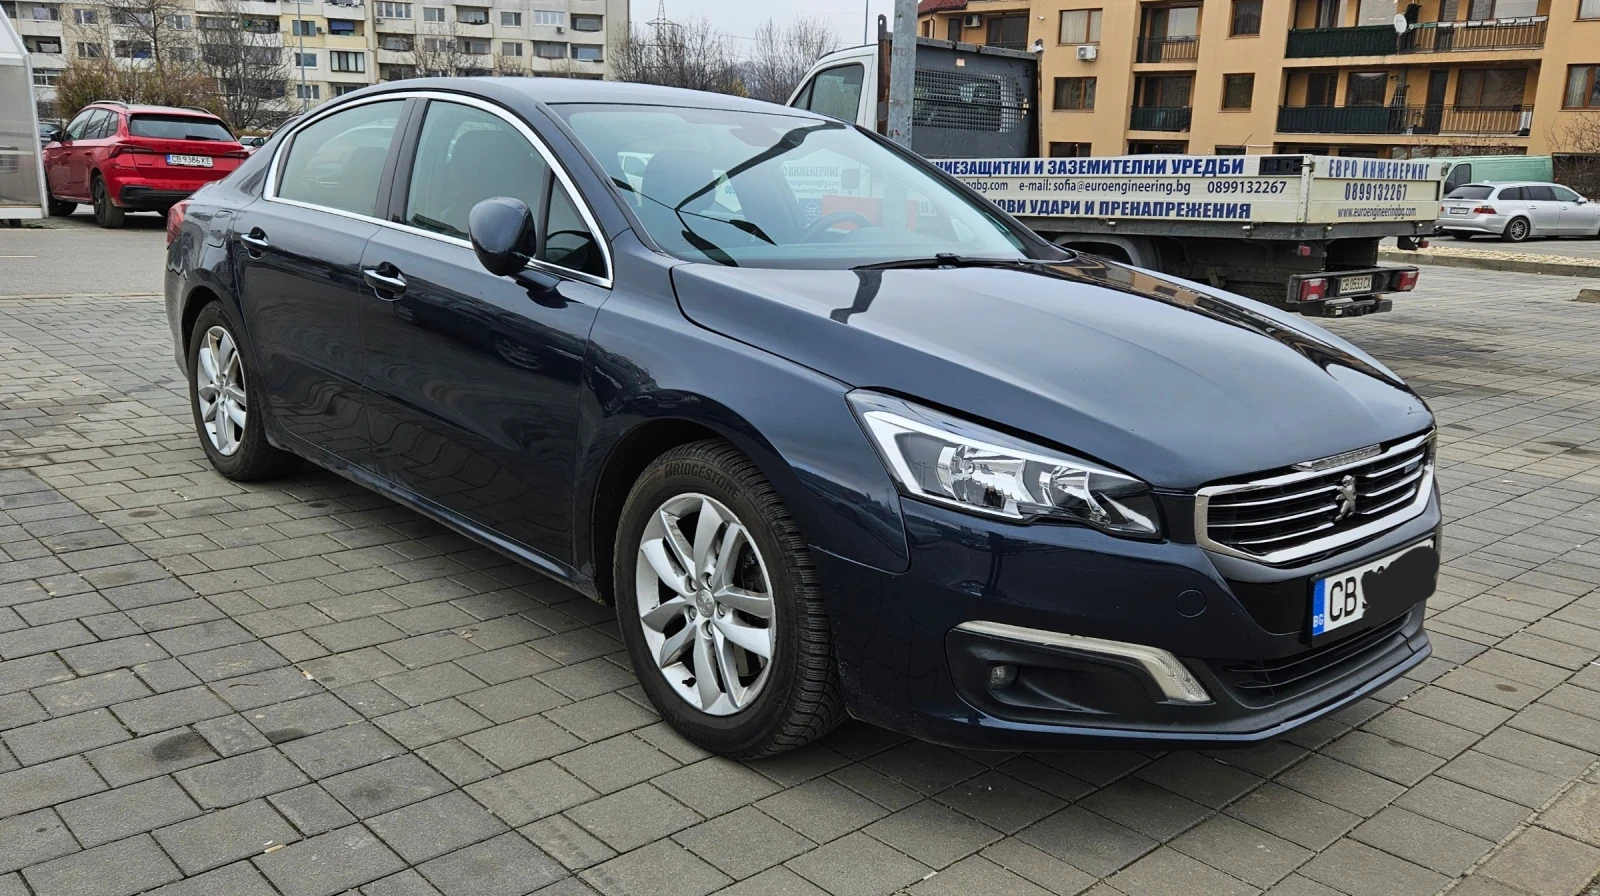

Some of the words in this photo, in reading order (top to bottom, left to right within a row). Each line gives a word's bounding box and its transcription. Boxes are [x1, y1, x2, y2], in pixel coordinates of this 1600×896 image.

[1034, 161, 1044, 175] И
[1048, 160, 1167, 175] ЗАЗЕМИТЕЛНИ
[1171, 159, 1245, 177] УРЕДБИ
[1328, 159, 1358, 178] ЕВРО
[1362, 161, 1430, 180] ИНЖЕНЕРИНГ
[1019, 179, 1052, 192] e-mail:
[1054, 179, 1191, 195] sofia@euroengineering.bg
[1207, 181, 1287, 194] 0899132267
[1344, 182, 1408, 200] 0899132267
[990, 199, 1026, 214] ОВИ
[1029, 200, 1081, 215] УДАРИ
[1084, 201, 1095, 215] И
[1099, 201, 1252, 219] ПРЕНАПРЕЖЕНИЯ
[1337, 204, 1417, 220] www.euroengineeringbg.com
[664, 460, 741, 501] BRIDGESTONE
[1329, 576, 1357, 622] CB
[1312, 613, 1324, 629] BG
